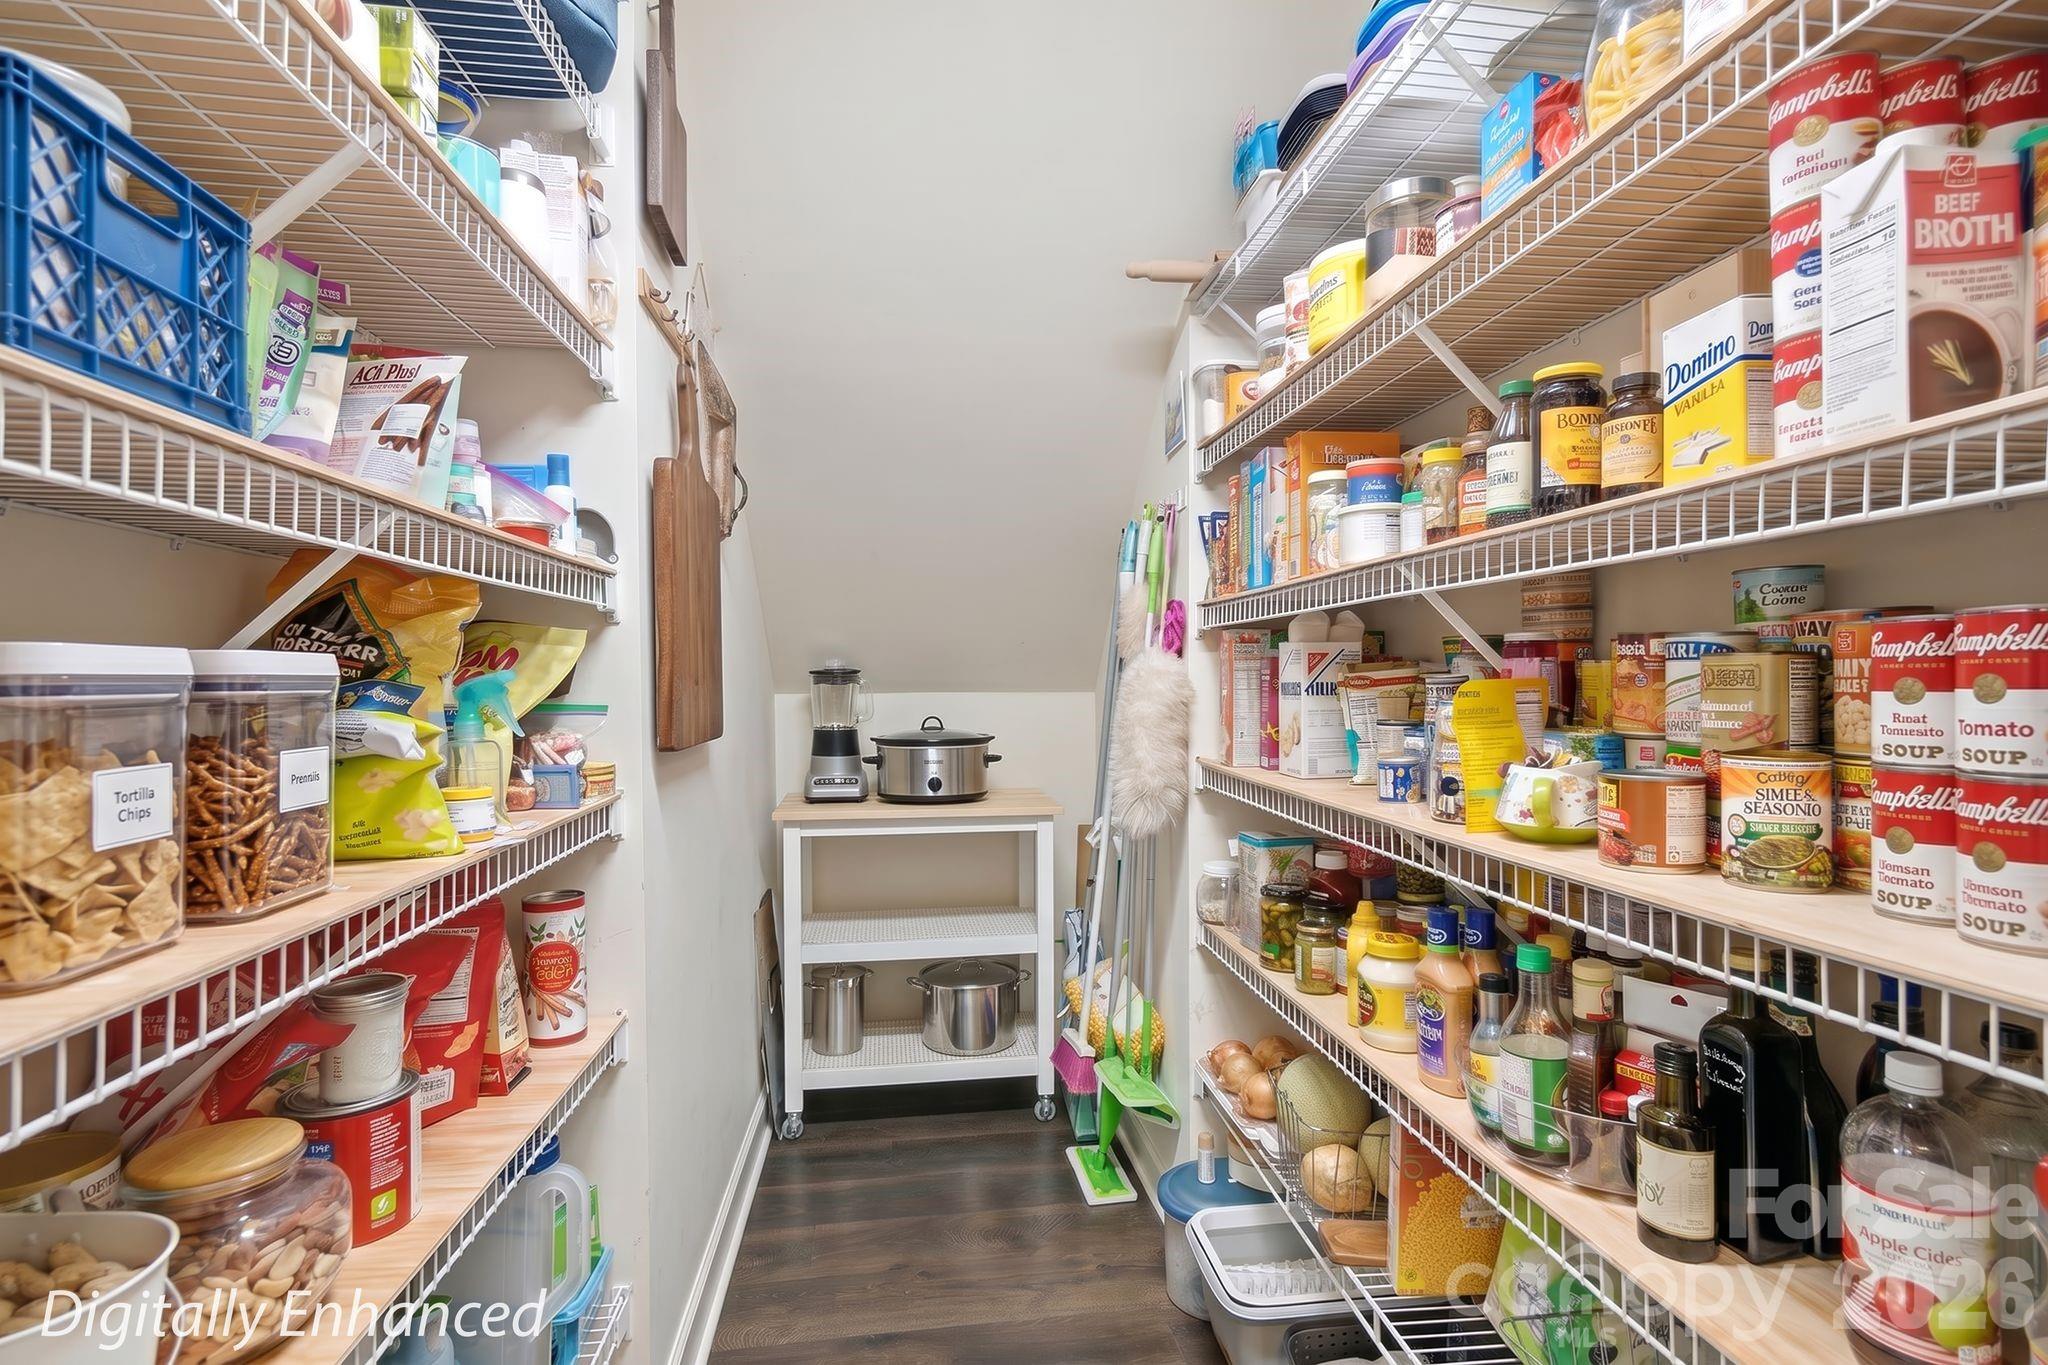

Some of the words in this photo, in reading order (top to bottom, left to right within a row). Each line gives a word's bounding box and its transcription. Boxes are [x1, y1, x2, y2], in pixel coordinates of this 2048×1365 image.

[1934, 192, 1982, 214] BEEF
[1914, 212, 2016, 249] BROTH
[1665, 335, 1736, 395] Domino
[1871, 631, 1956, 662] Campbell
[1958, 719, 2035, 738] Tomato
[1882, 743, 1944, 759] SOUP
[1962, 748, 2028, 765] SOUP
[114, 786, 156, 803] Tortilla
[118, 805, 151, 824] Chips
[1877, 889, 1933, 910] SOUP
[1962, 912, 2027, 937] SOUP
[1860, 1225, 1908, 1255] Apple
